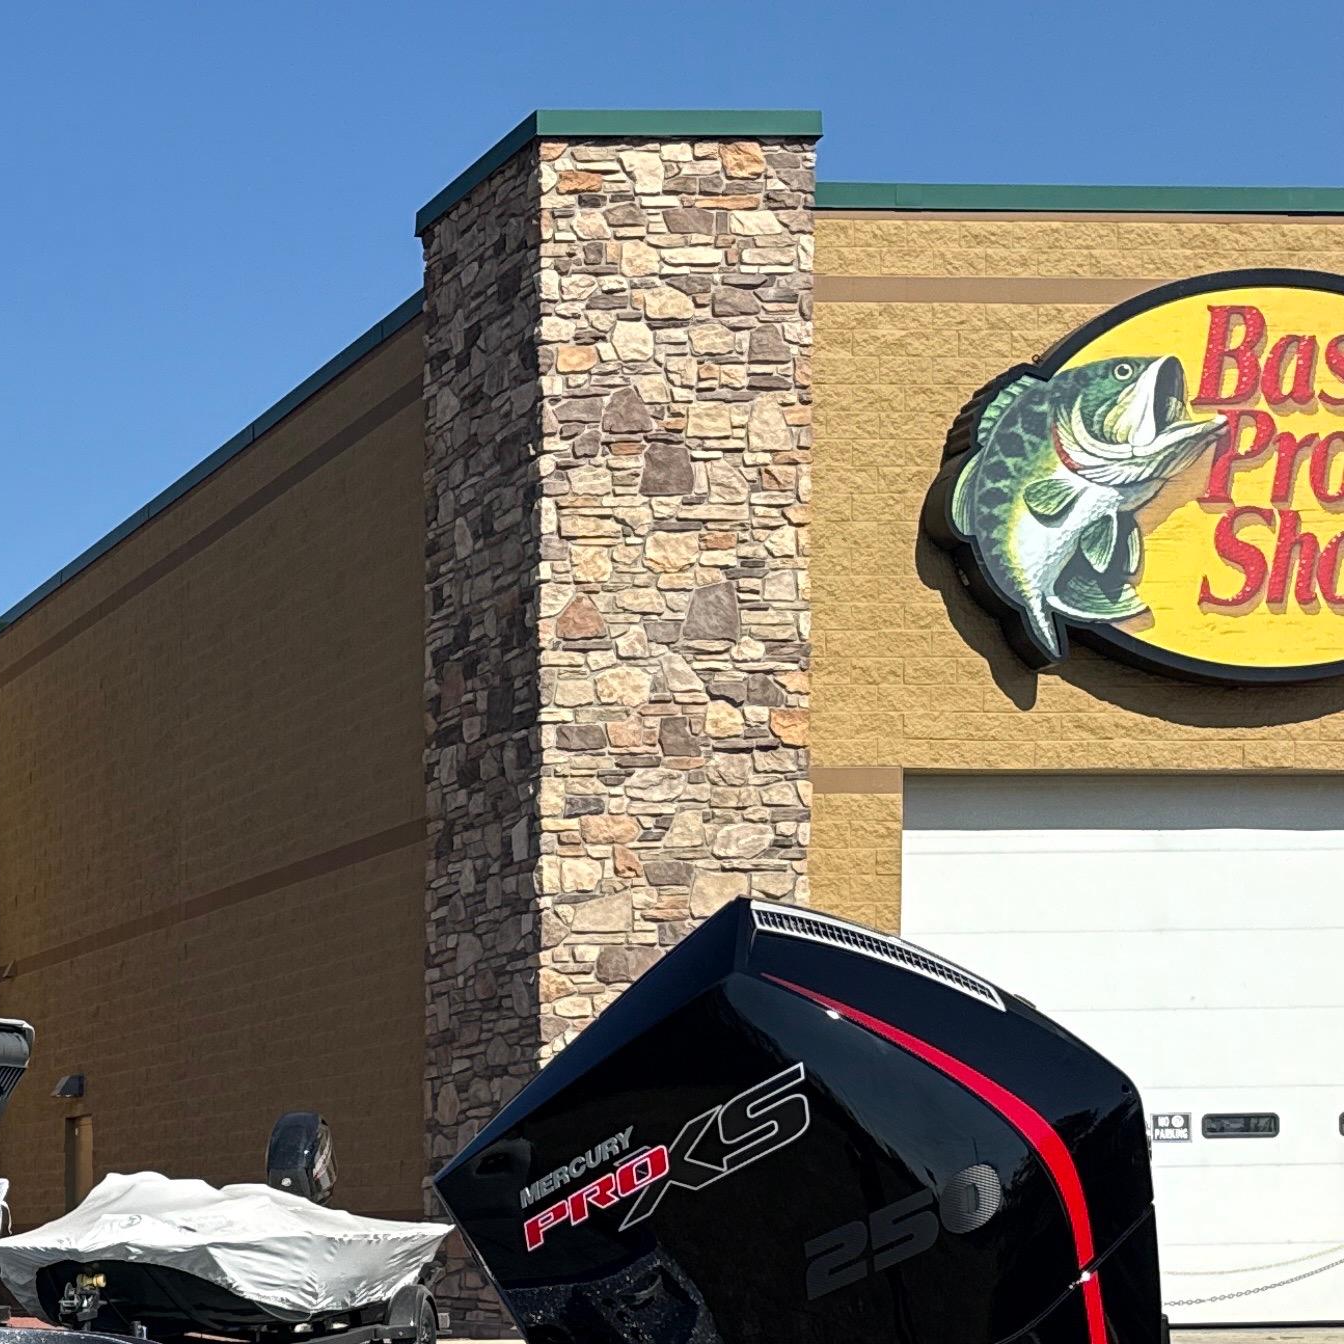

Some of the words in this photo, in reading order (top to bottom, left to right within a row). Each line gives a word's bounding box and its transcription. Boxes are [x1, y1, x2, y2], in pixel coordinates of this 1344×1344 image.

[1198, 408, 1344, 503] Pro
[1154, 1128, 1188, 1140] PARKING
[1157, 1116, 1170, 1127] NO
[519, 1126, 634, 1209] MERCURY
[524, 1145, 669, 1251] PRO
[804, 1164, 1002, 1301] 250
